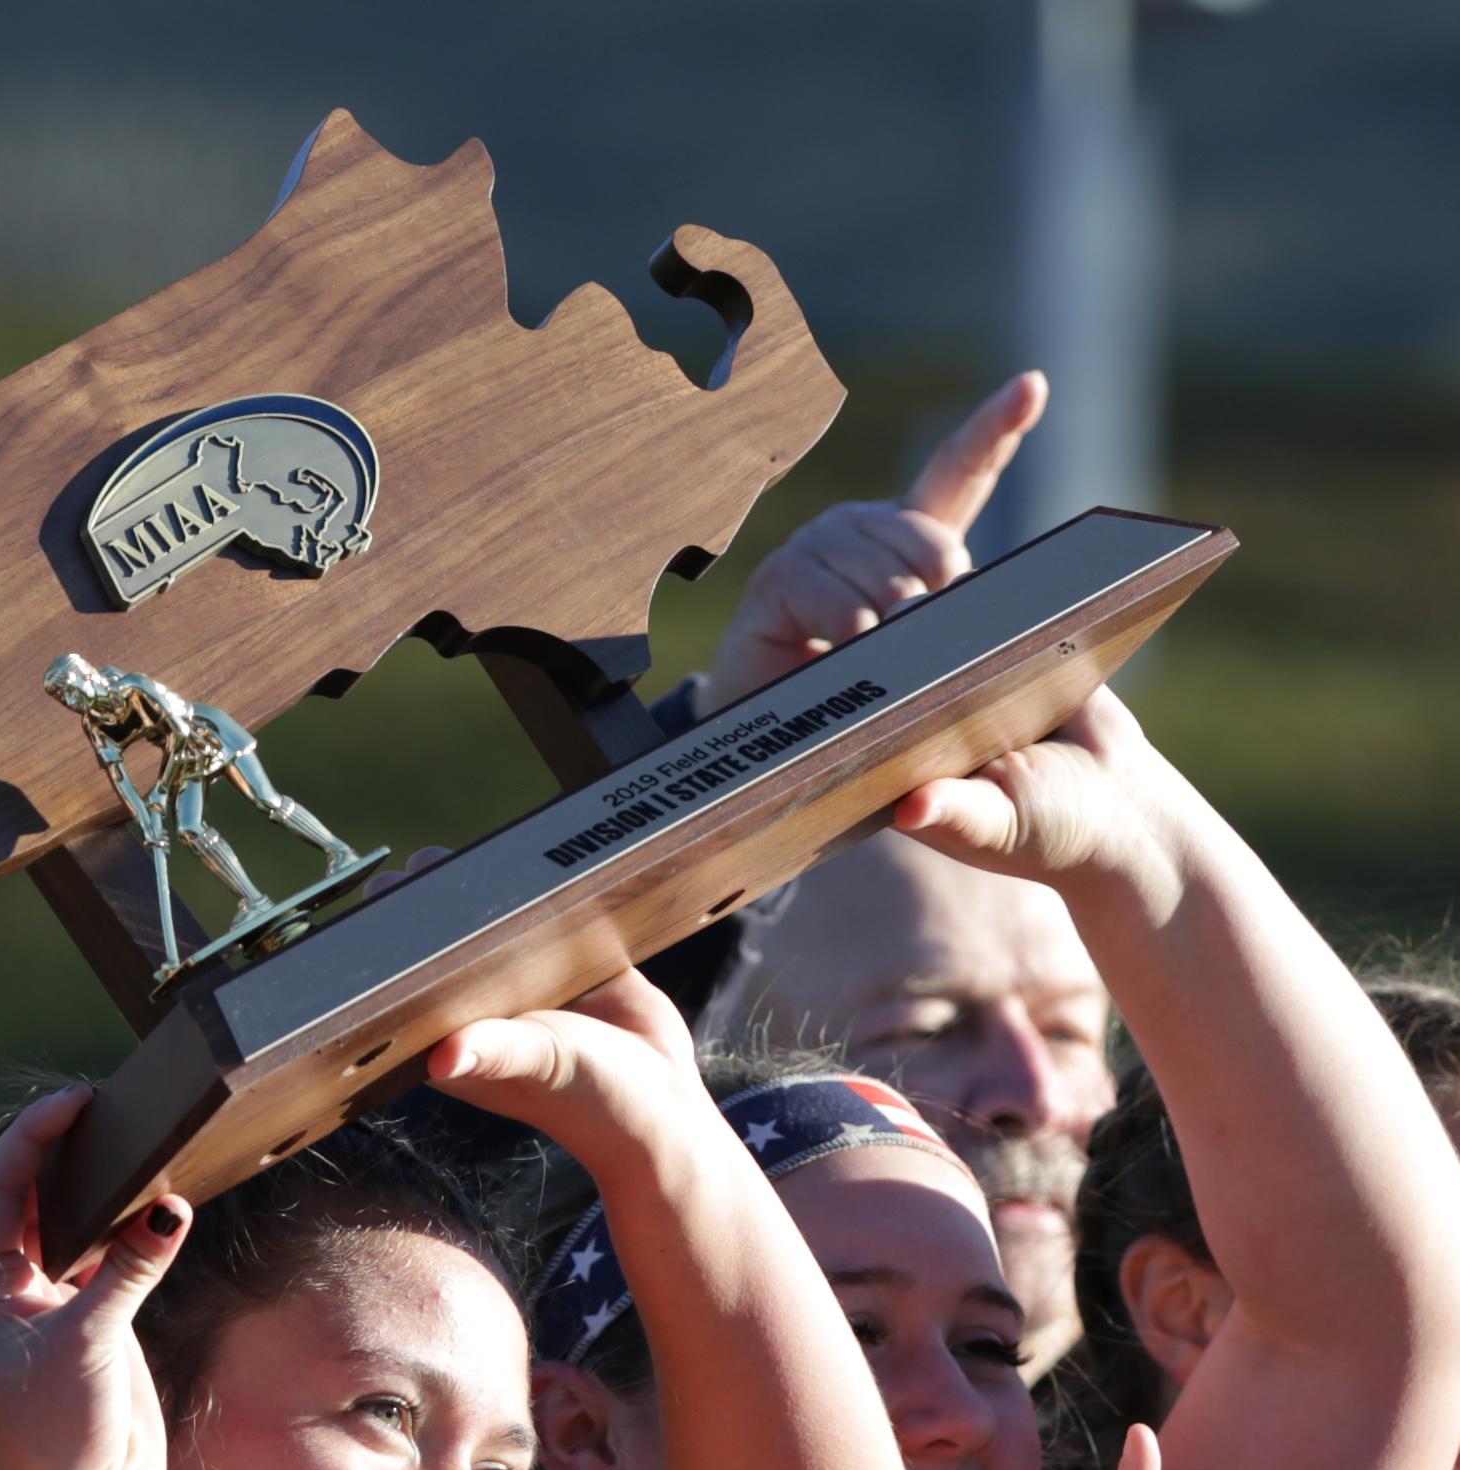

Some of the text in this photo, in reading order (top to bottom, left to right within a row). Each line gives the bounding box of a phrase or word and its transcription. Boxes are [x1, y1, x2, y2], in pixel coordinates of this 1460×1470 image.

[107, 483, 241, 577] MIAA
[543, 799, 666, 869] DIVISION
[664, 753, 751, 803] STATE
[736, 678, 888, 764] CHAMPIONS
[602, 709, 782, 808] 2019 Field Hockey
